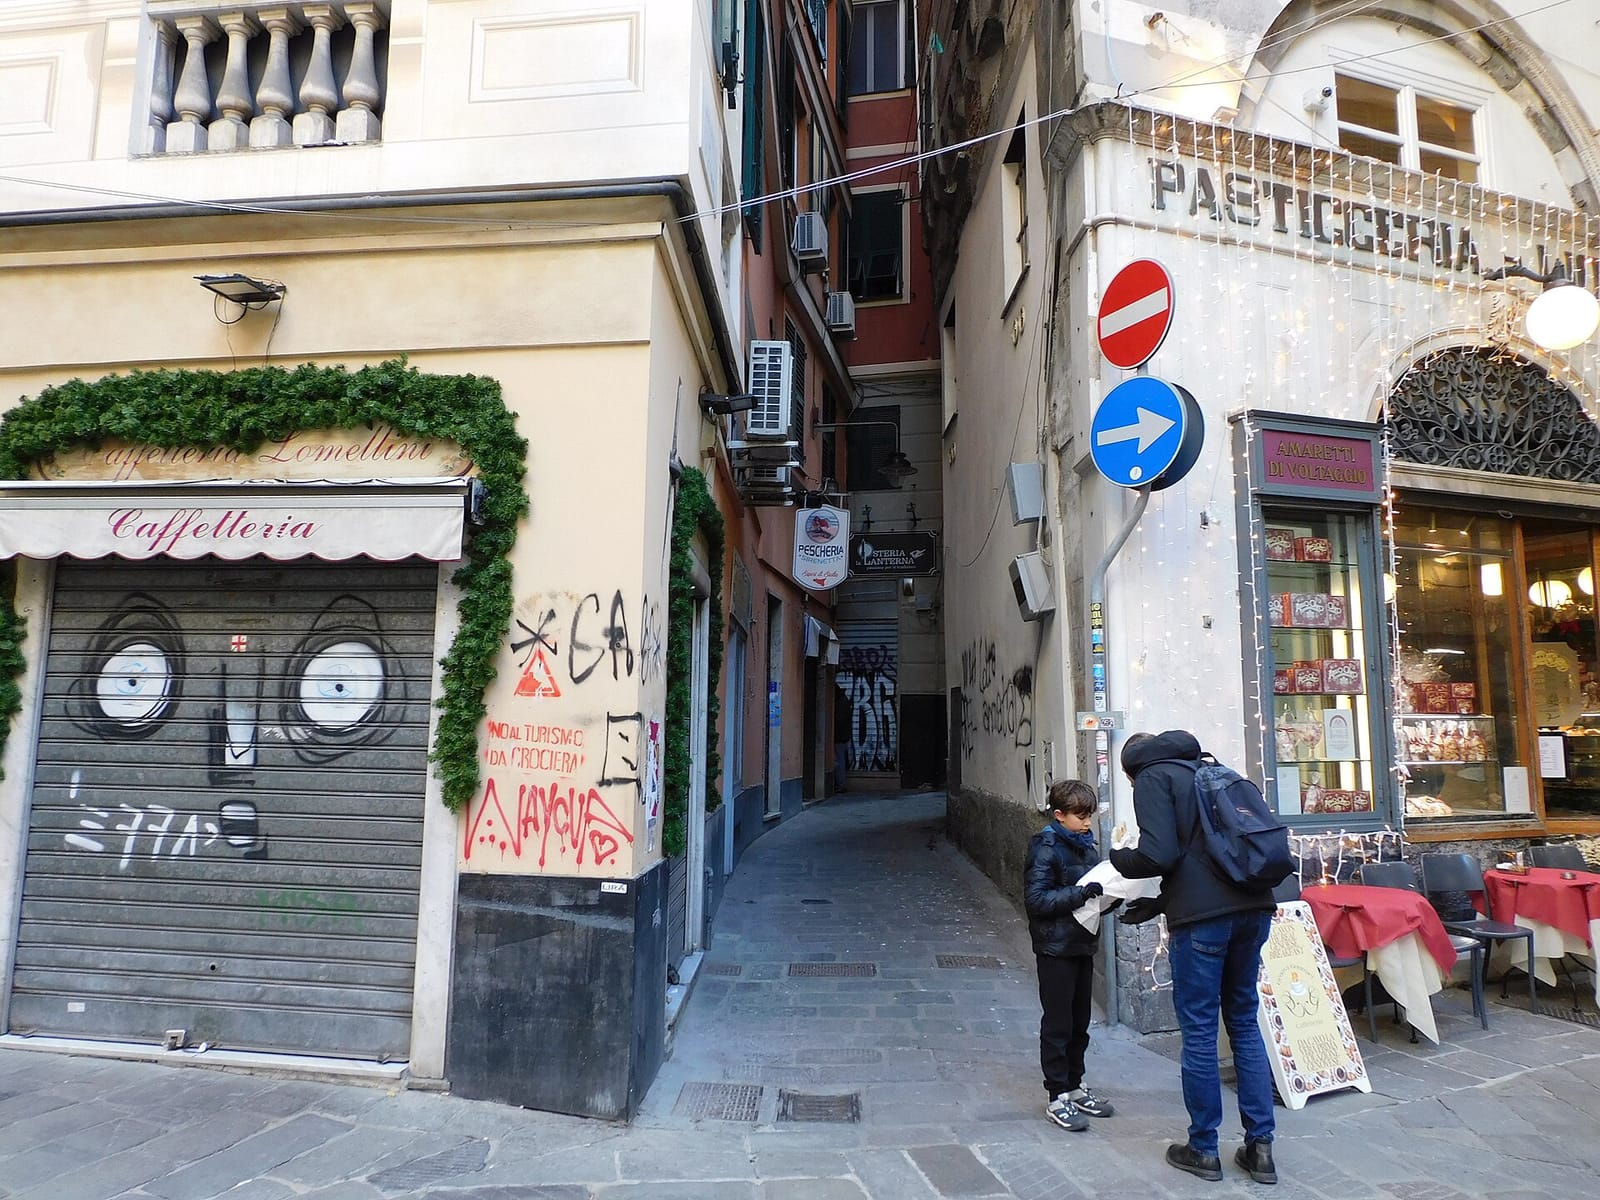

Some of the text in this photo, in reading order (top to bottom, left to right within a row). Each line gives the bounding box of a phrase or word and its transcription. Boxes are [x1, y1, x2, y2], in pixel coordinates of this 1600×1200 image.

[1147, 157, 1480, 275] PASTICCERIA
[258, 424, 433, 463] Lomellini
[1276, 440, 1356, 462] AMARETTI
[1269, 461, 1367, 484] DI VOLTAGGIO
[108, 508, 324, 552] Caffetteria
[798, 544, 845, 558] PESCHERIA
[524, 724, 584, 747] TURISMO
[489, 750, 507, 767] DA
